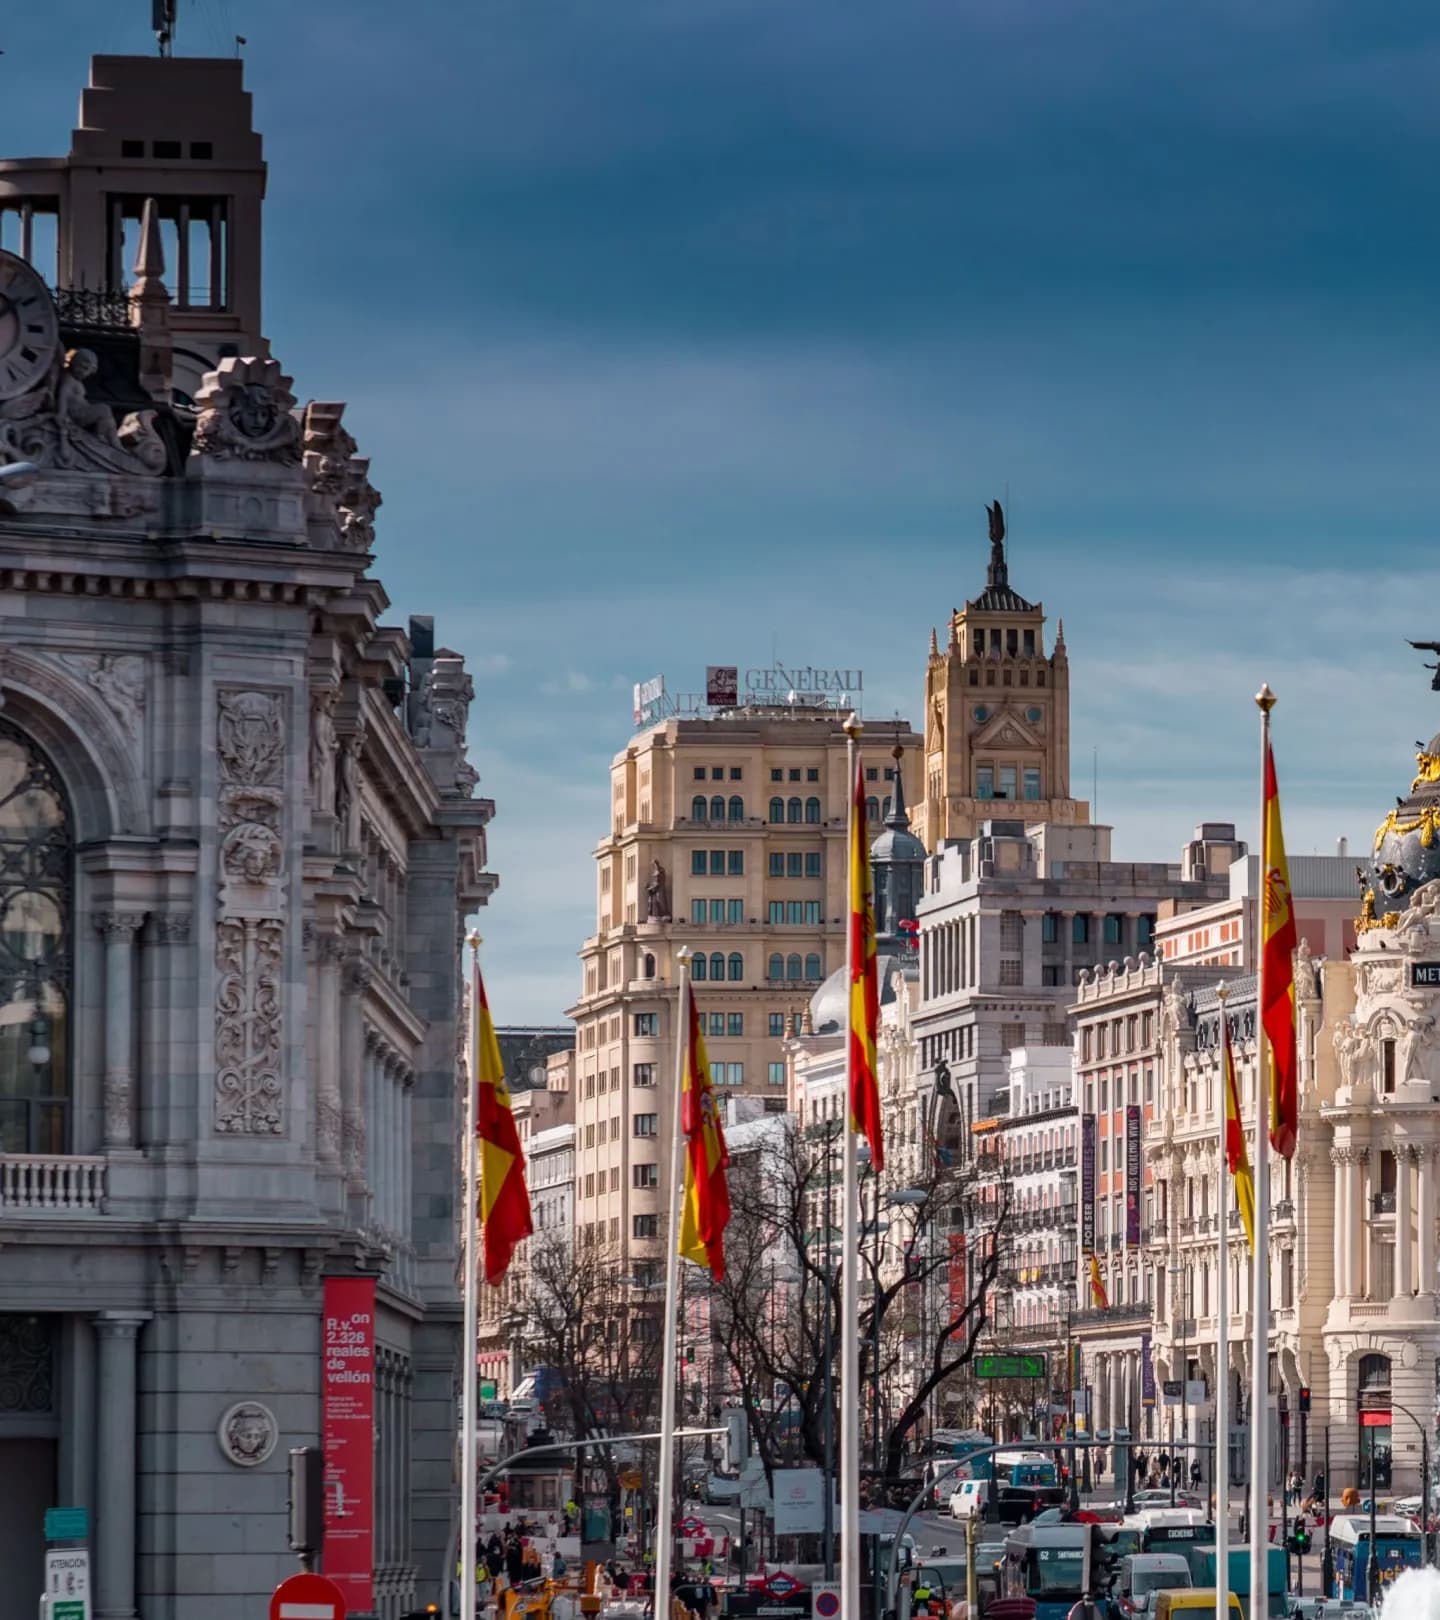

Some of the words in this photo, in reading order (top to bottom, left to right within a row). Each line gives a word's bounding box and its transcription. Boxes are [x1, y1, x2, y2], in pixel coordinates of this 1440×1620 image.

[745, 669, 864, 691] GENERALI
[1128, 1139, 1138, 1176] QUEREMOS
[1128, 1178, 1138, 1192] NOS
[1084, 1203, 1094, 1221] SER
[1084, 1222, 1094, 1246] POR
[327, 1344, 370, 1357] reales
[327, 1358, 346, 1370] de
[327, 1370, 371, 1383] vellón
